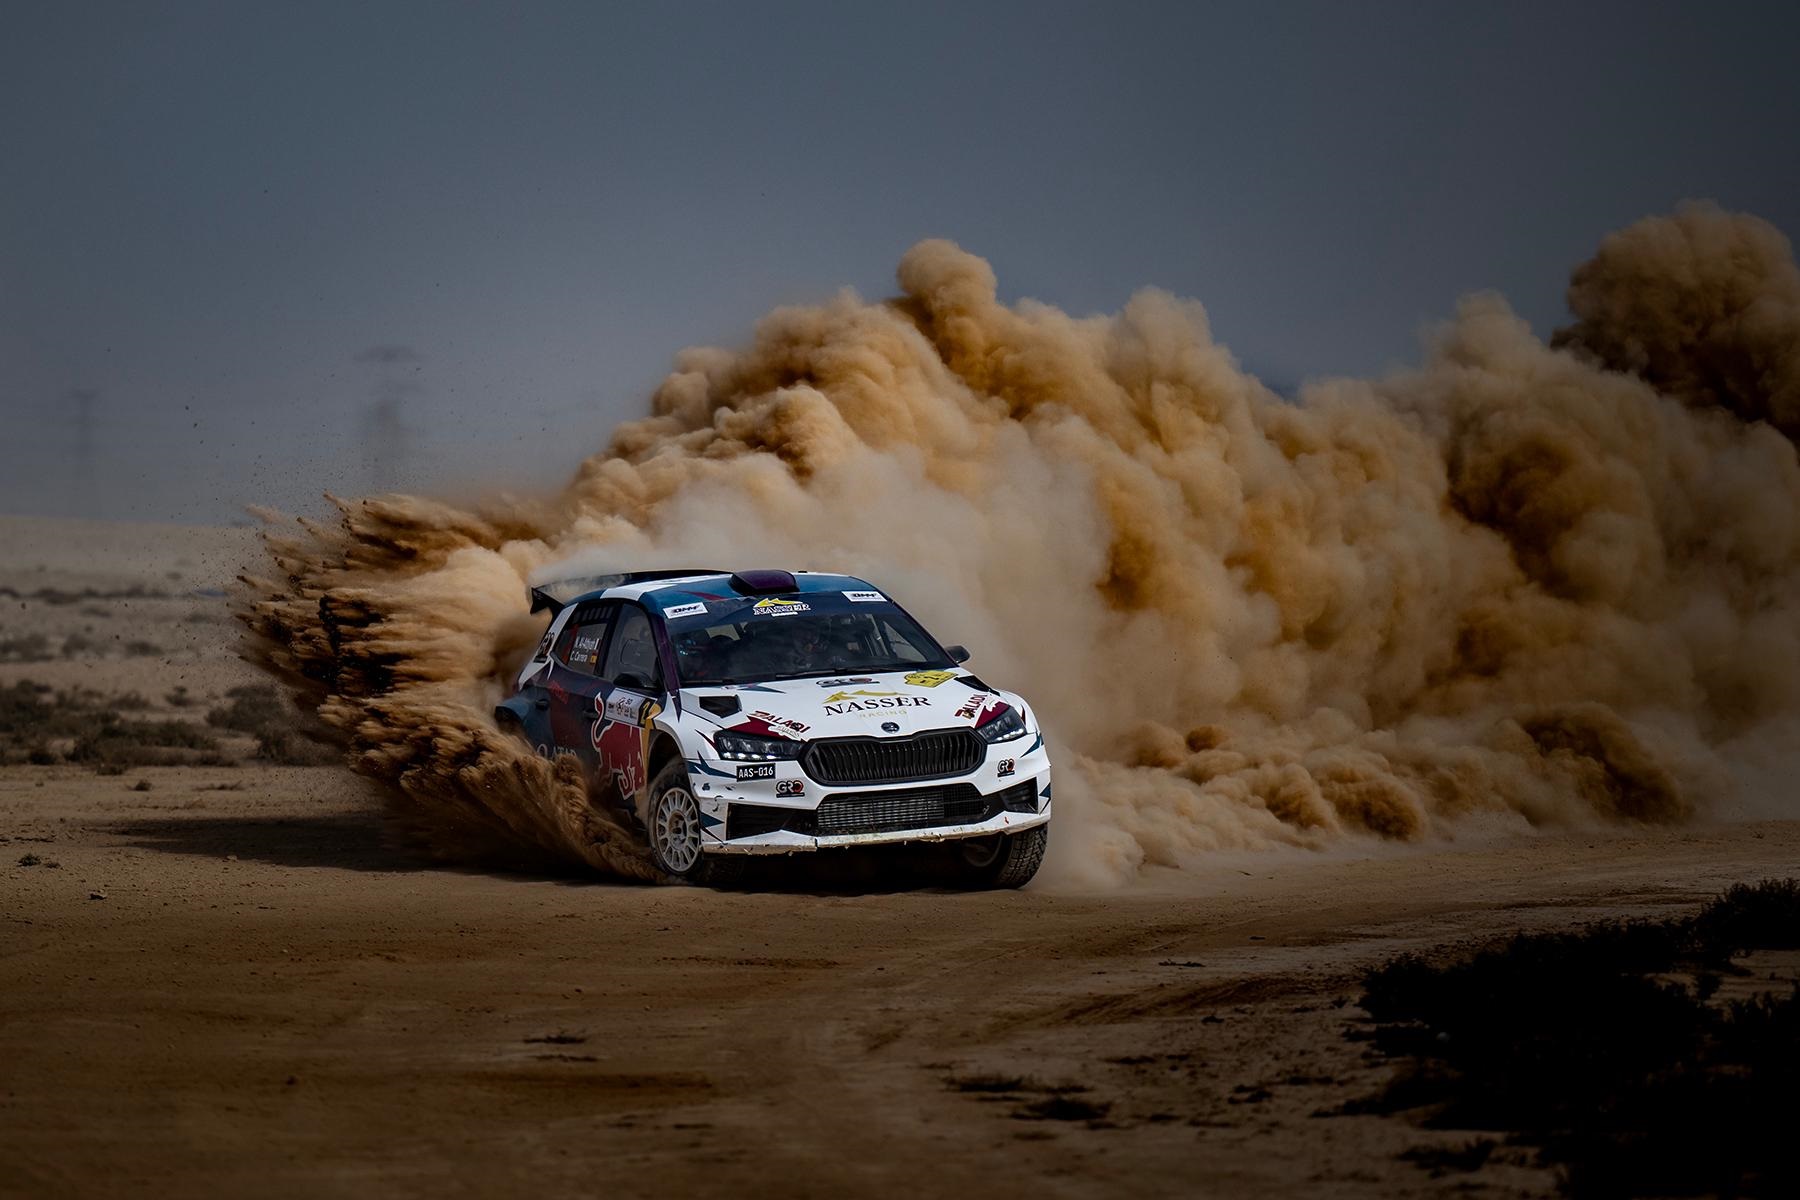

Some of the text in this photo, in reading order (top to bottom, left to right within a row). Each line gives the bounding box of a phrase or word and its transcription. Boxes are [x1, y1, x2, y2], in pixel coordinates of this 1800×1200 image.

[753, 603, 811, 616] NASSER
[823, 696, 932, 717] NASSER
[776, 780, 804, 794] GRO
